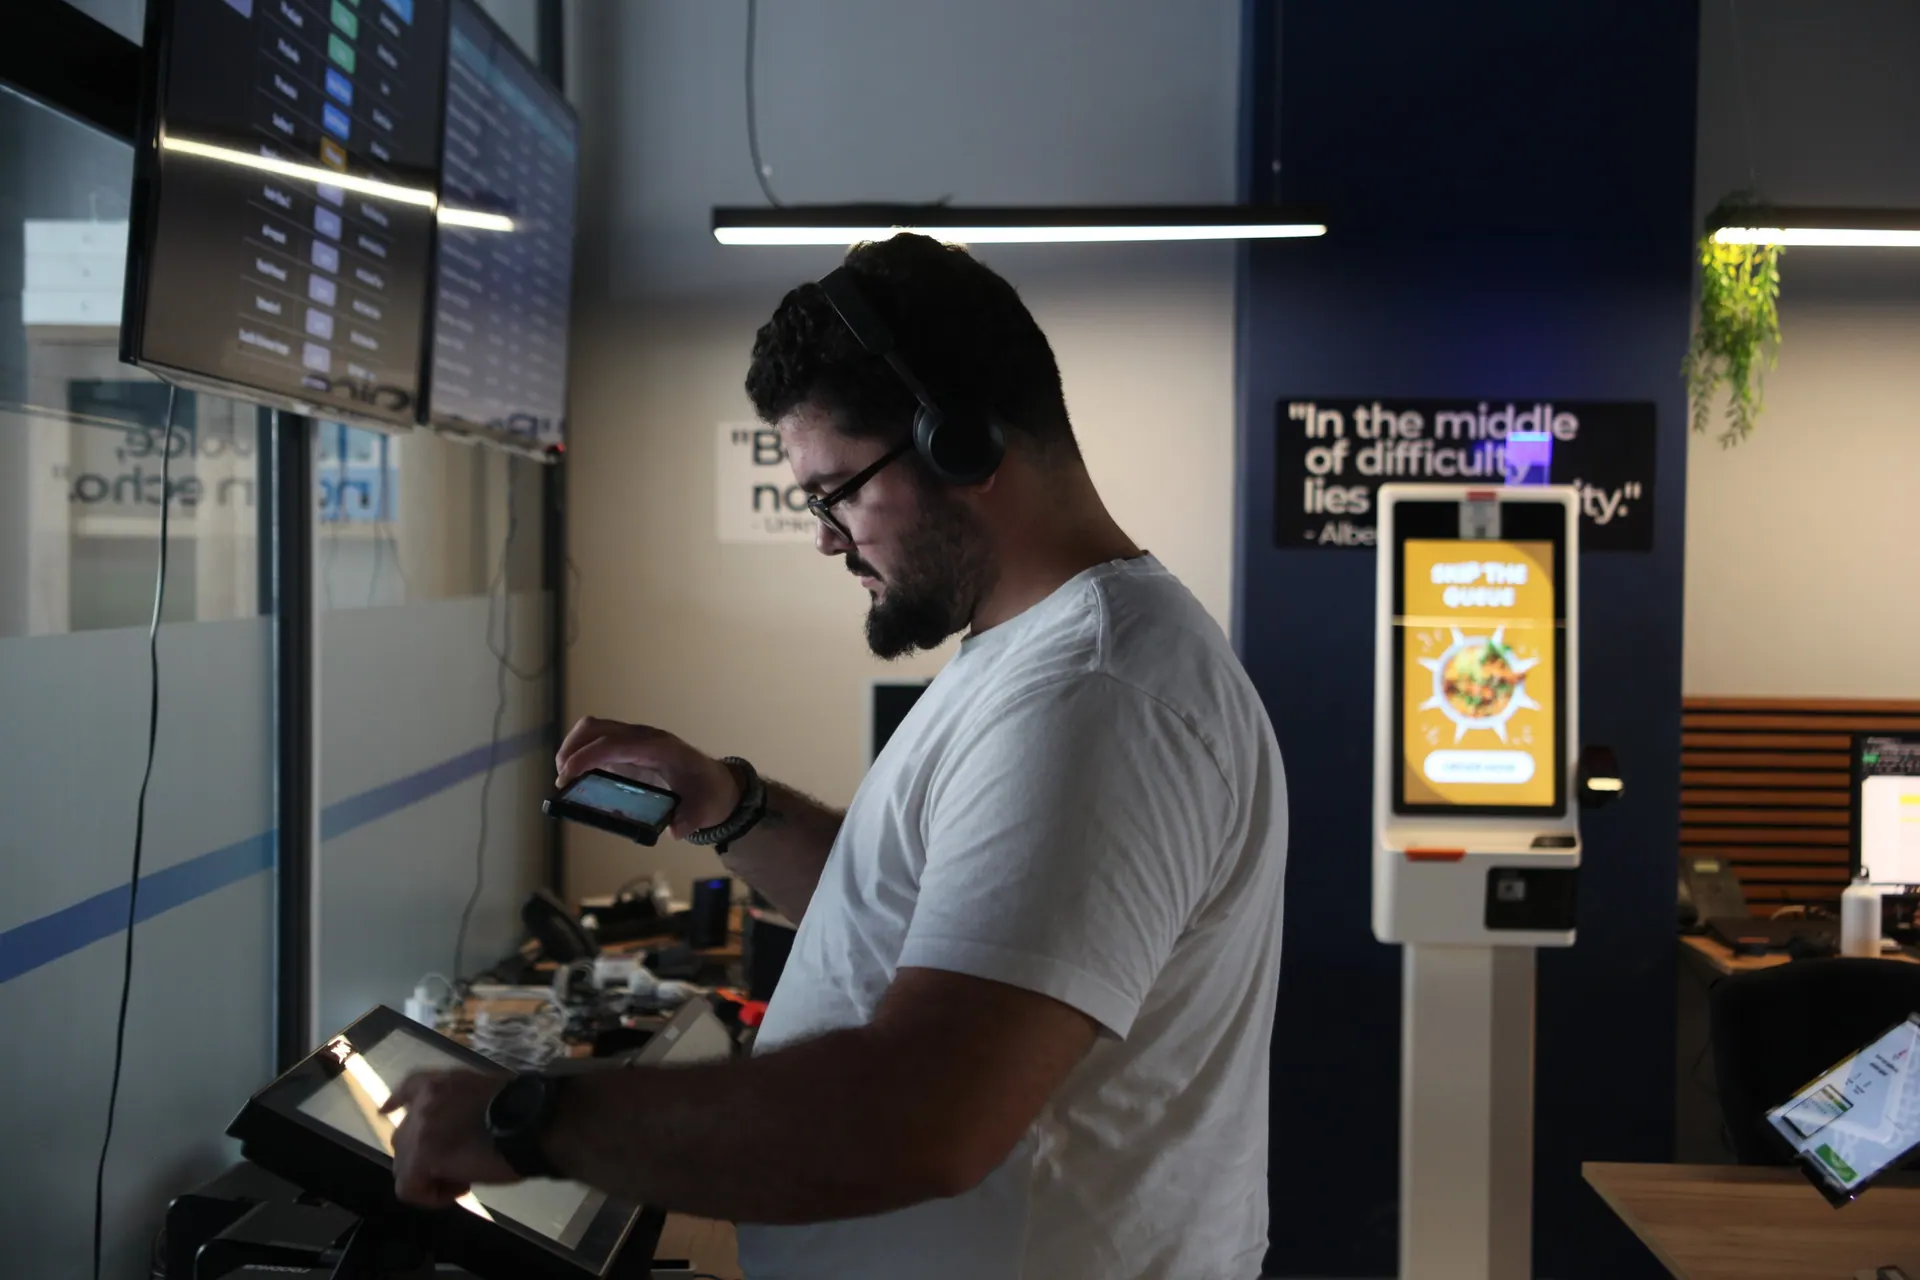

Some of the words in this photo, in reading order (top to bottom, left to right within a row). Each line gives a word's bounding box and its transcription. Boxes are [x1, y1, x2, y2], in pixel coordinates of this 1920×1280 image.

[1288, 402, 1344, 439] "In
[1355, 402, 1424, 440] the
[1434, 402, 1579, 440] middle
[731, 428, 788, 466] "B
[1304, 439, 1350, 476] of
[1355, 440, 1532, 484] difficulty
[752, 483, 808, 513] no
[1303, 478, 1370, 515] lies
[1573, 479, 1642, 524] ity."
[1318, 521, 1377, 546] Albe
